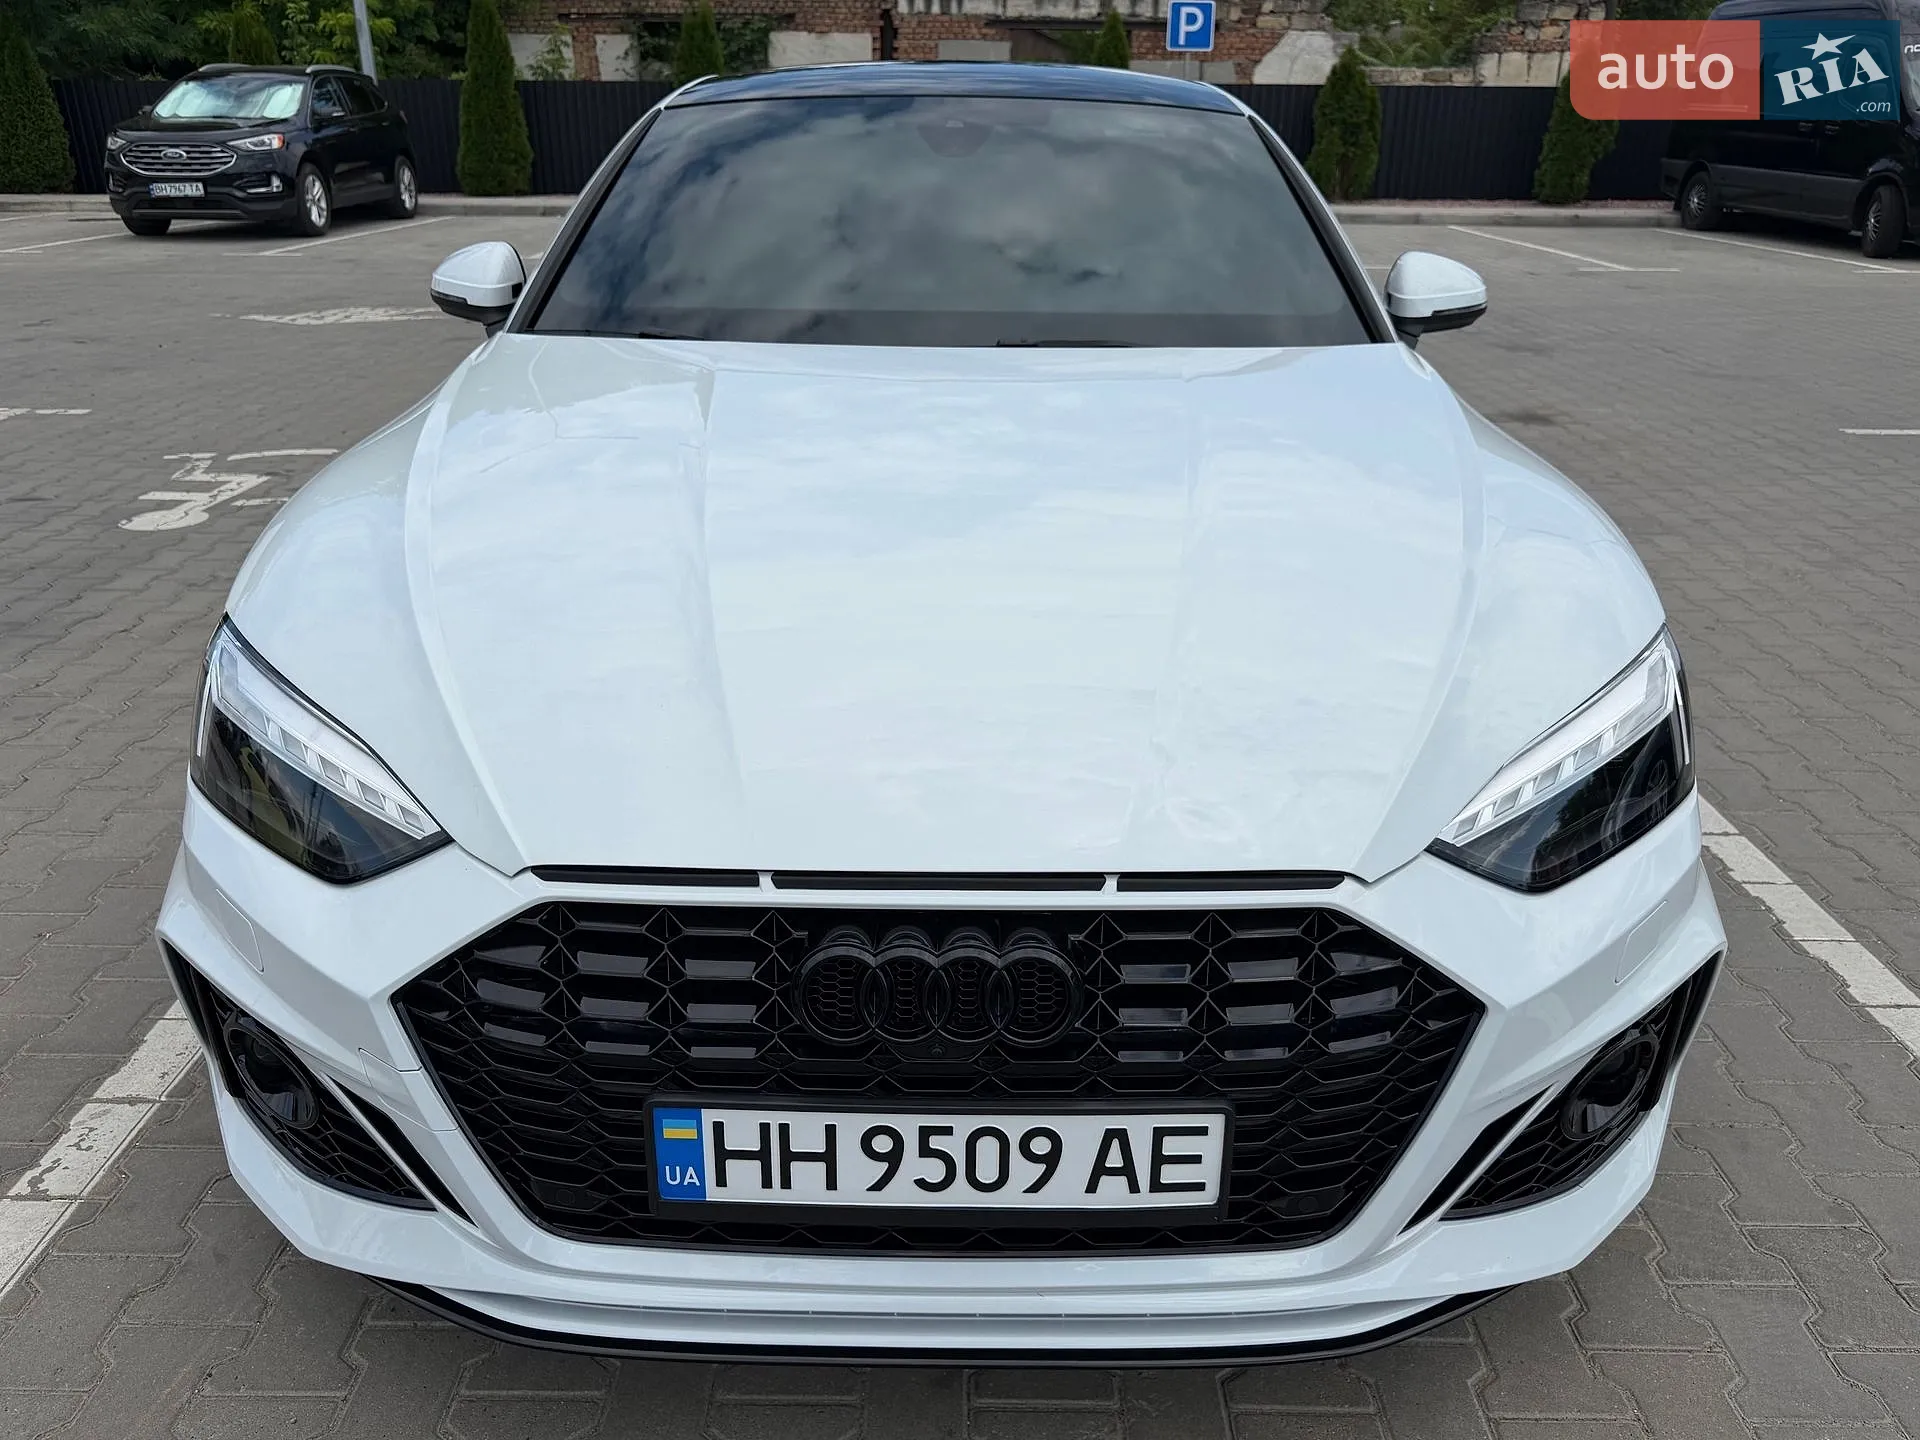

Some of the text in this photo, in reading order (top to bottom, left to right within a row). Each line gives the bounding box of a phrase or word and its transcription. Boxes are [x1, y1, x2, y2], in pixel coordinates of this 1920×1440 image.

[1178, 6, 1204, 45] P
[665, 1165, 701, 1186] UA
[712, 1120, 1209, 1194] HH 9509 AE
